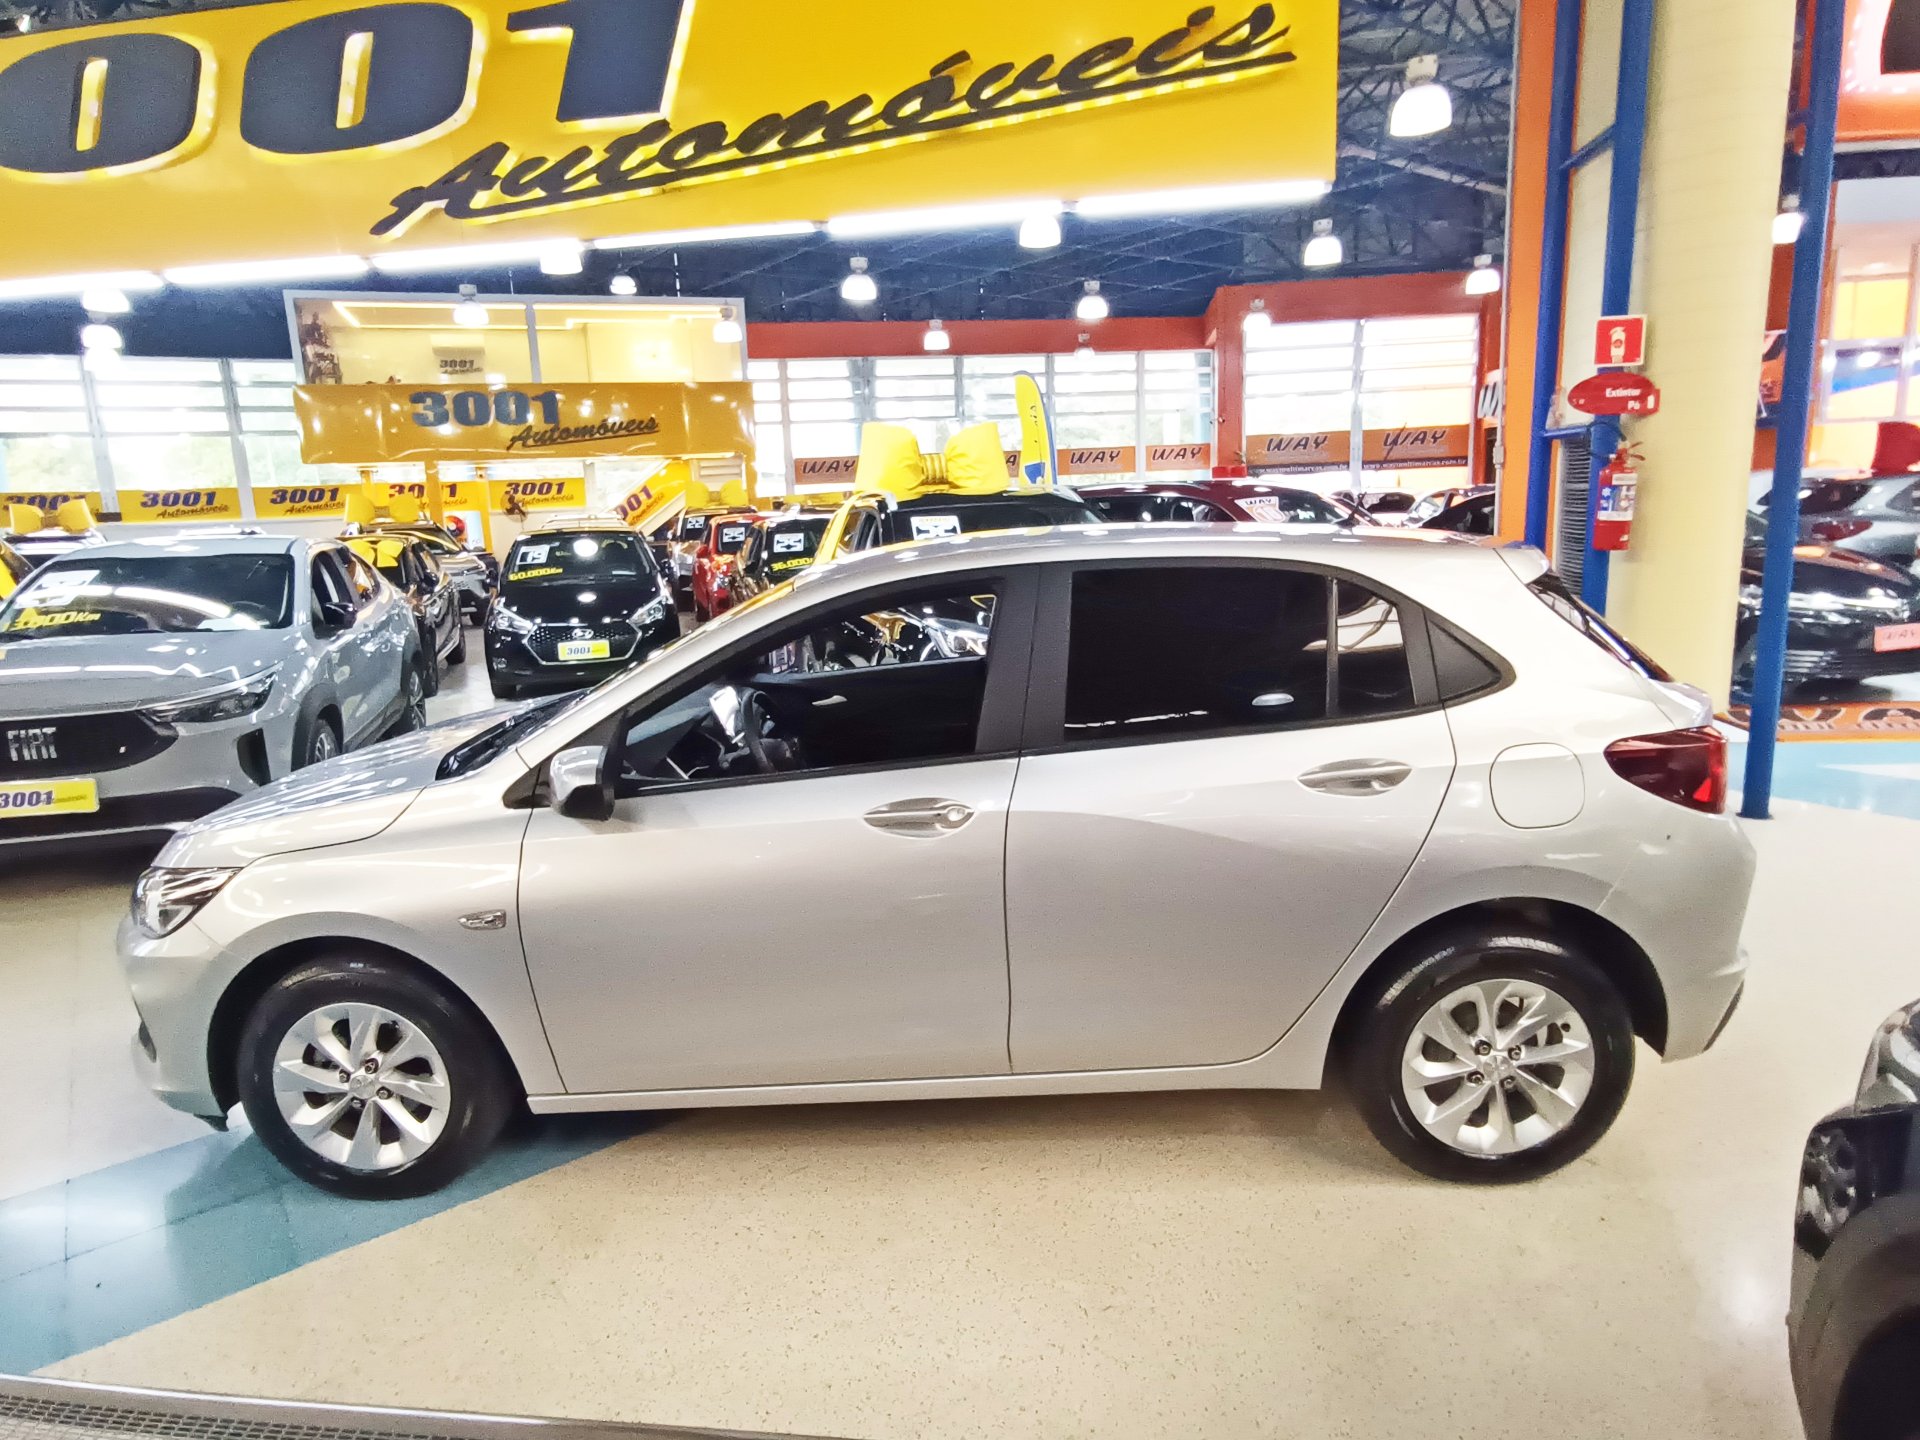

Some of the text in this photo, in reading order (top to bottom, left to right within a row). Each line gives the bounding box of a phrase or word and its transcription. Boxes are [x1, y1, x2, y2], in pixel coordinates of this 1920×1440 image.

[369, 3, 1297, 235] Automóveis
[439, 359, 474, 368] 3001
[1606, 387, 1641, 397] Extintor
[408, 391, 561, 427] 3001
[506, 416, 659, 451] Automóveis
[1383, 429, 1447, 446] WAY
[1266, 435, 1328, 451] WAY
[1070, 450, 1120, 464] WAY
[1152, 447, 1202, 461] WAY
[802, 460, 856, 475] WAY
[270, 487, 340, 505] 3001
[505, 481, 565, 495] 3001
[140, 491, 216, 508] 3001
[8, 727, 57, 761] FIAT
[0, 790, 54, 808] 3001
